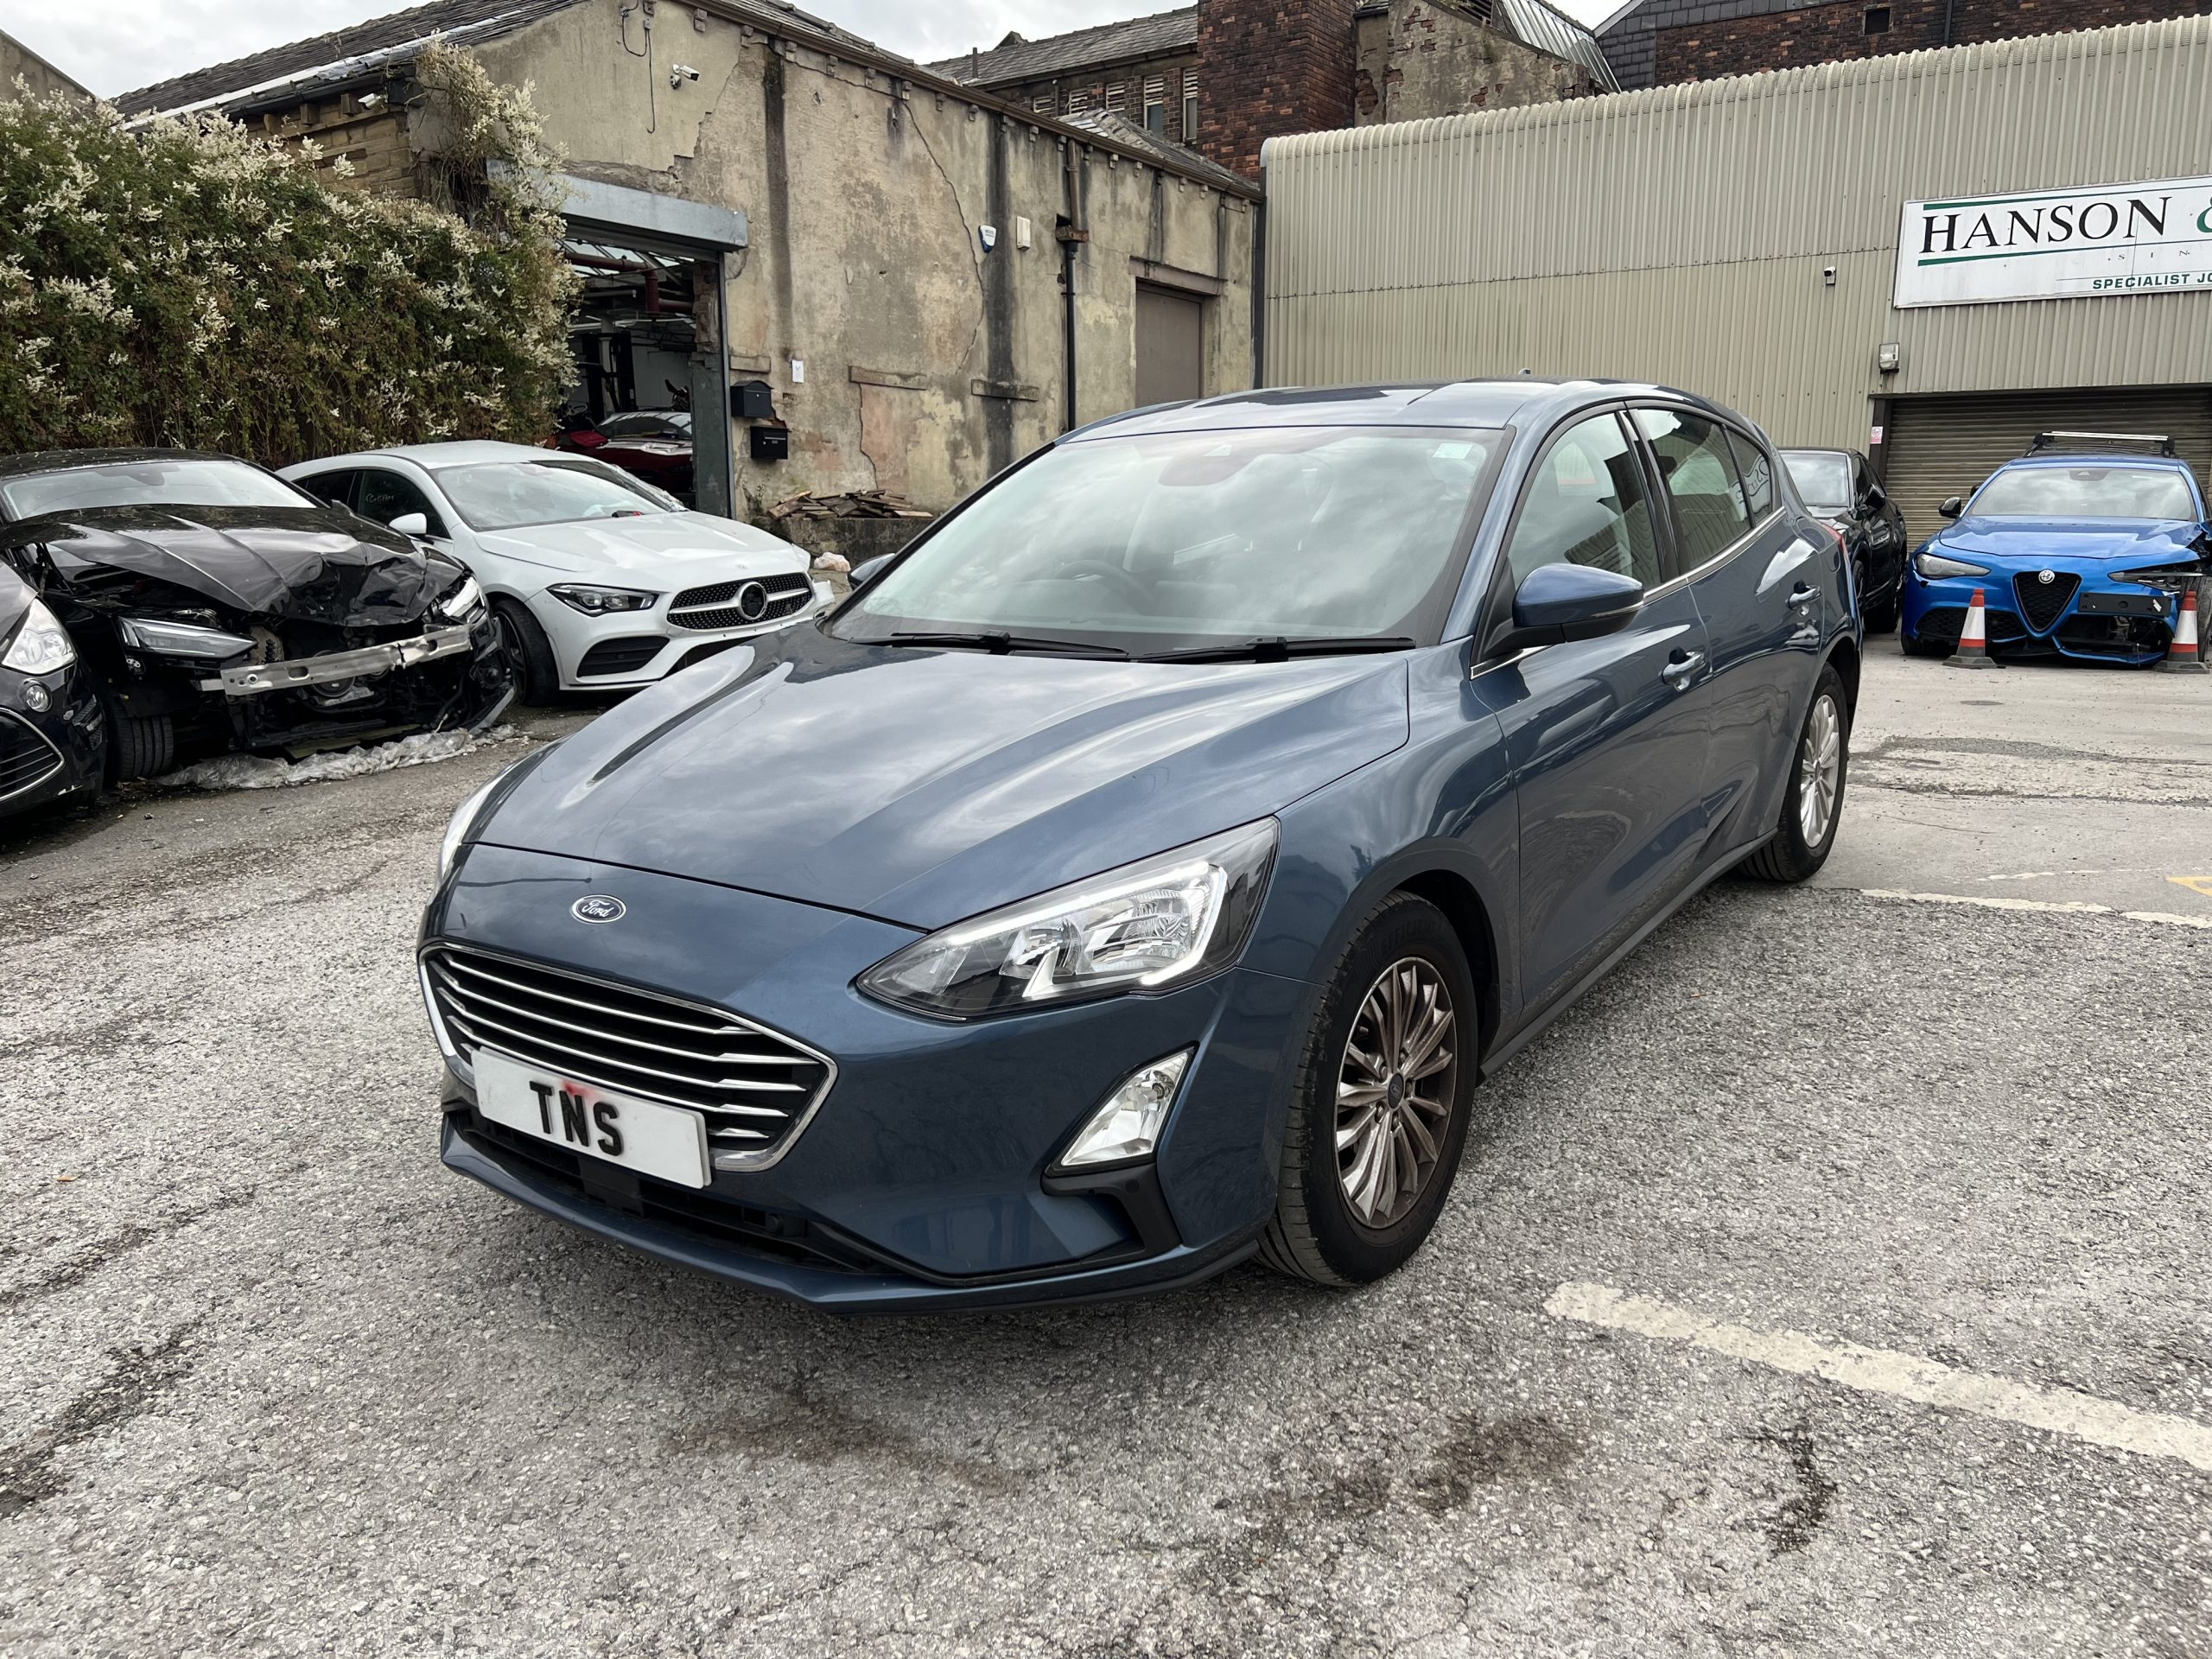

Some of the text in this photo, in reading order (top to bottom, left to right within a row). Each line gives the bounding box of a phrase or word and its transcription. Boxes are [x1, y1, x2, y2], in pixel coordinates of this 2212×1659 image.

[1919, 196, 2172, 254] HANSON
[2093, 273, 2190, 289] SPECIALIST
[582, 899, 614, 918] Ford
[529, 1080, 624, 1157] TNS
